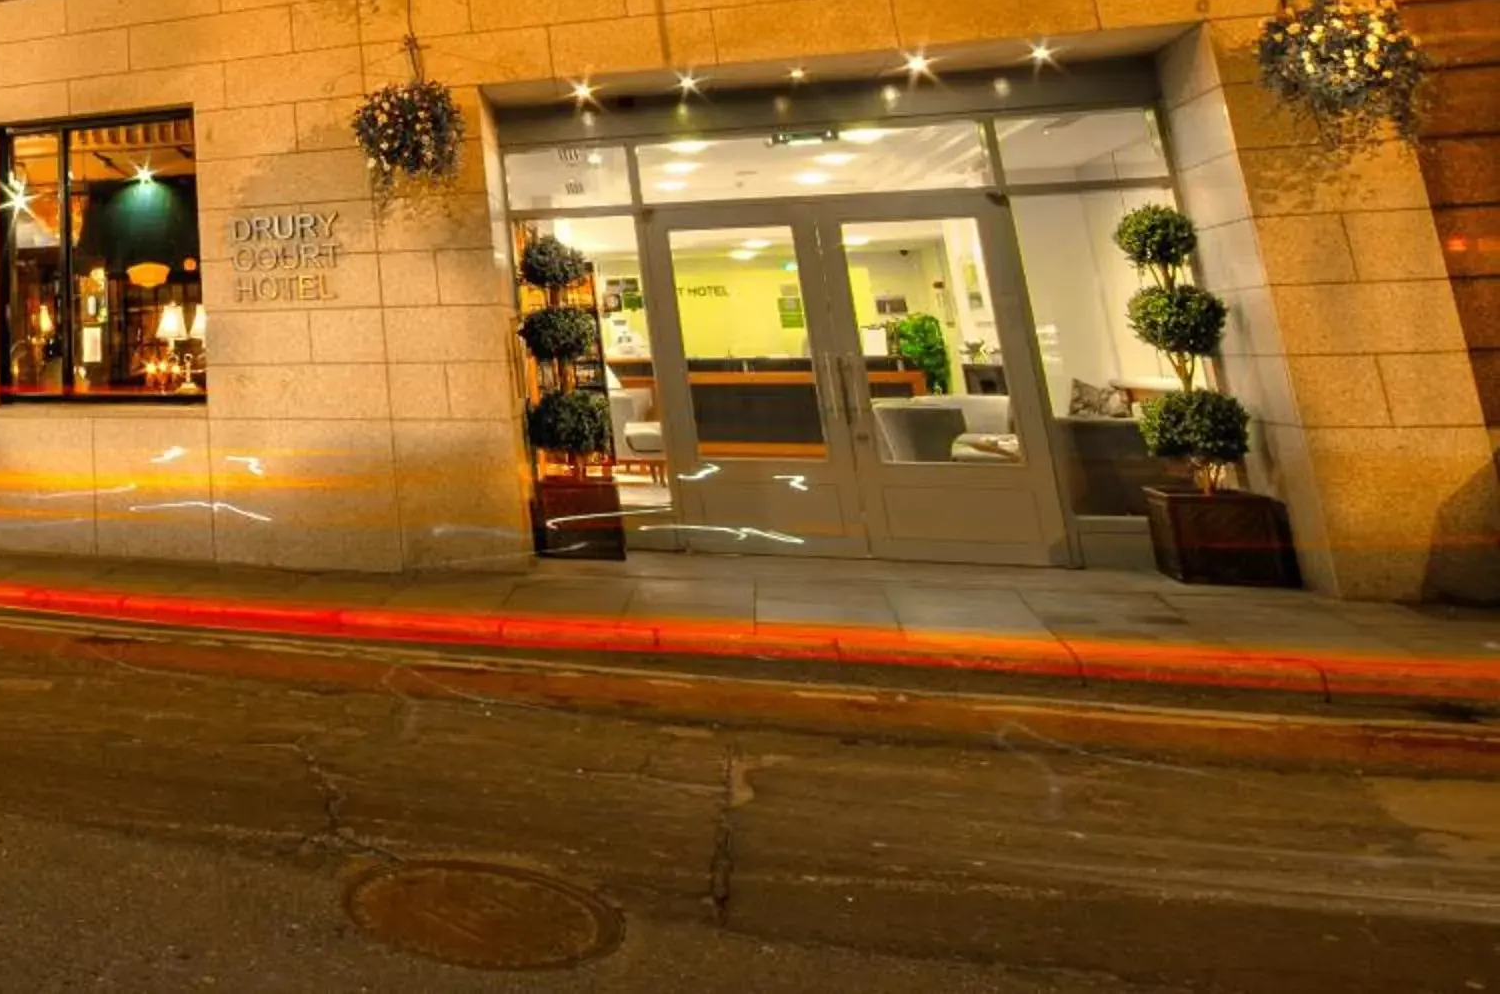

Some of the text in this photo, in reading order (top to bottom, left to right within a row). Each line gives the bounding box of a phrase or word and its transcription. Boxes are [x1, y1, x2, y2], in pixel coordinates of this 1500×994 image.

[233, 211, 339, 243] DRURY
[233, 243, 341, 272] COURT
[235, 274, 338, 303] HOTEL
[687, 285, 730, 297] HOTEL
